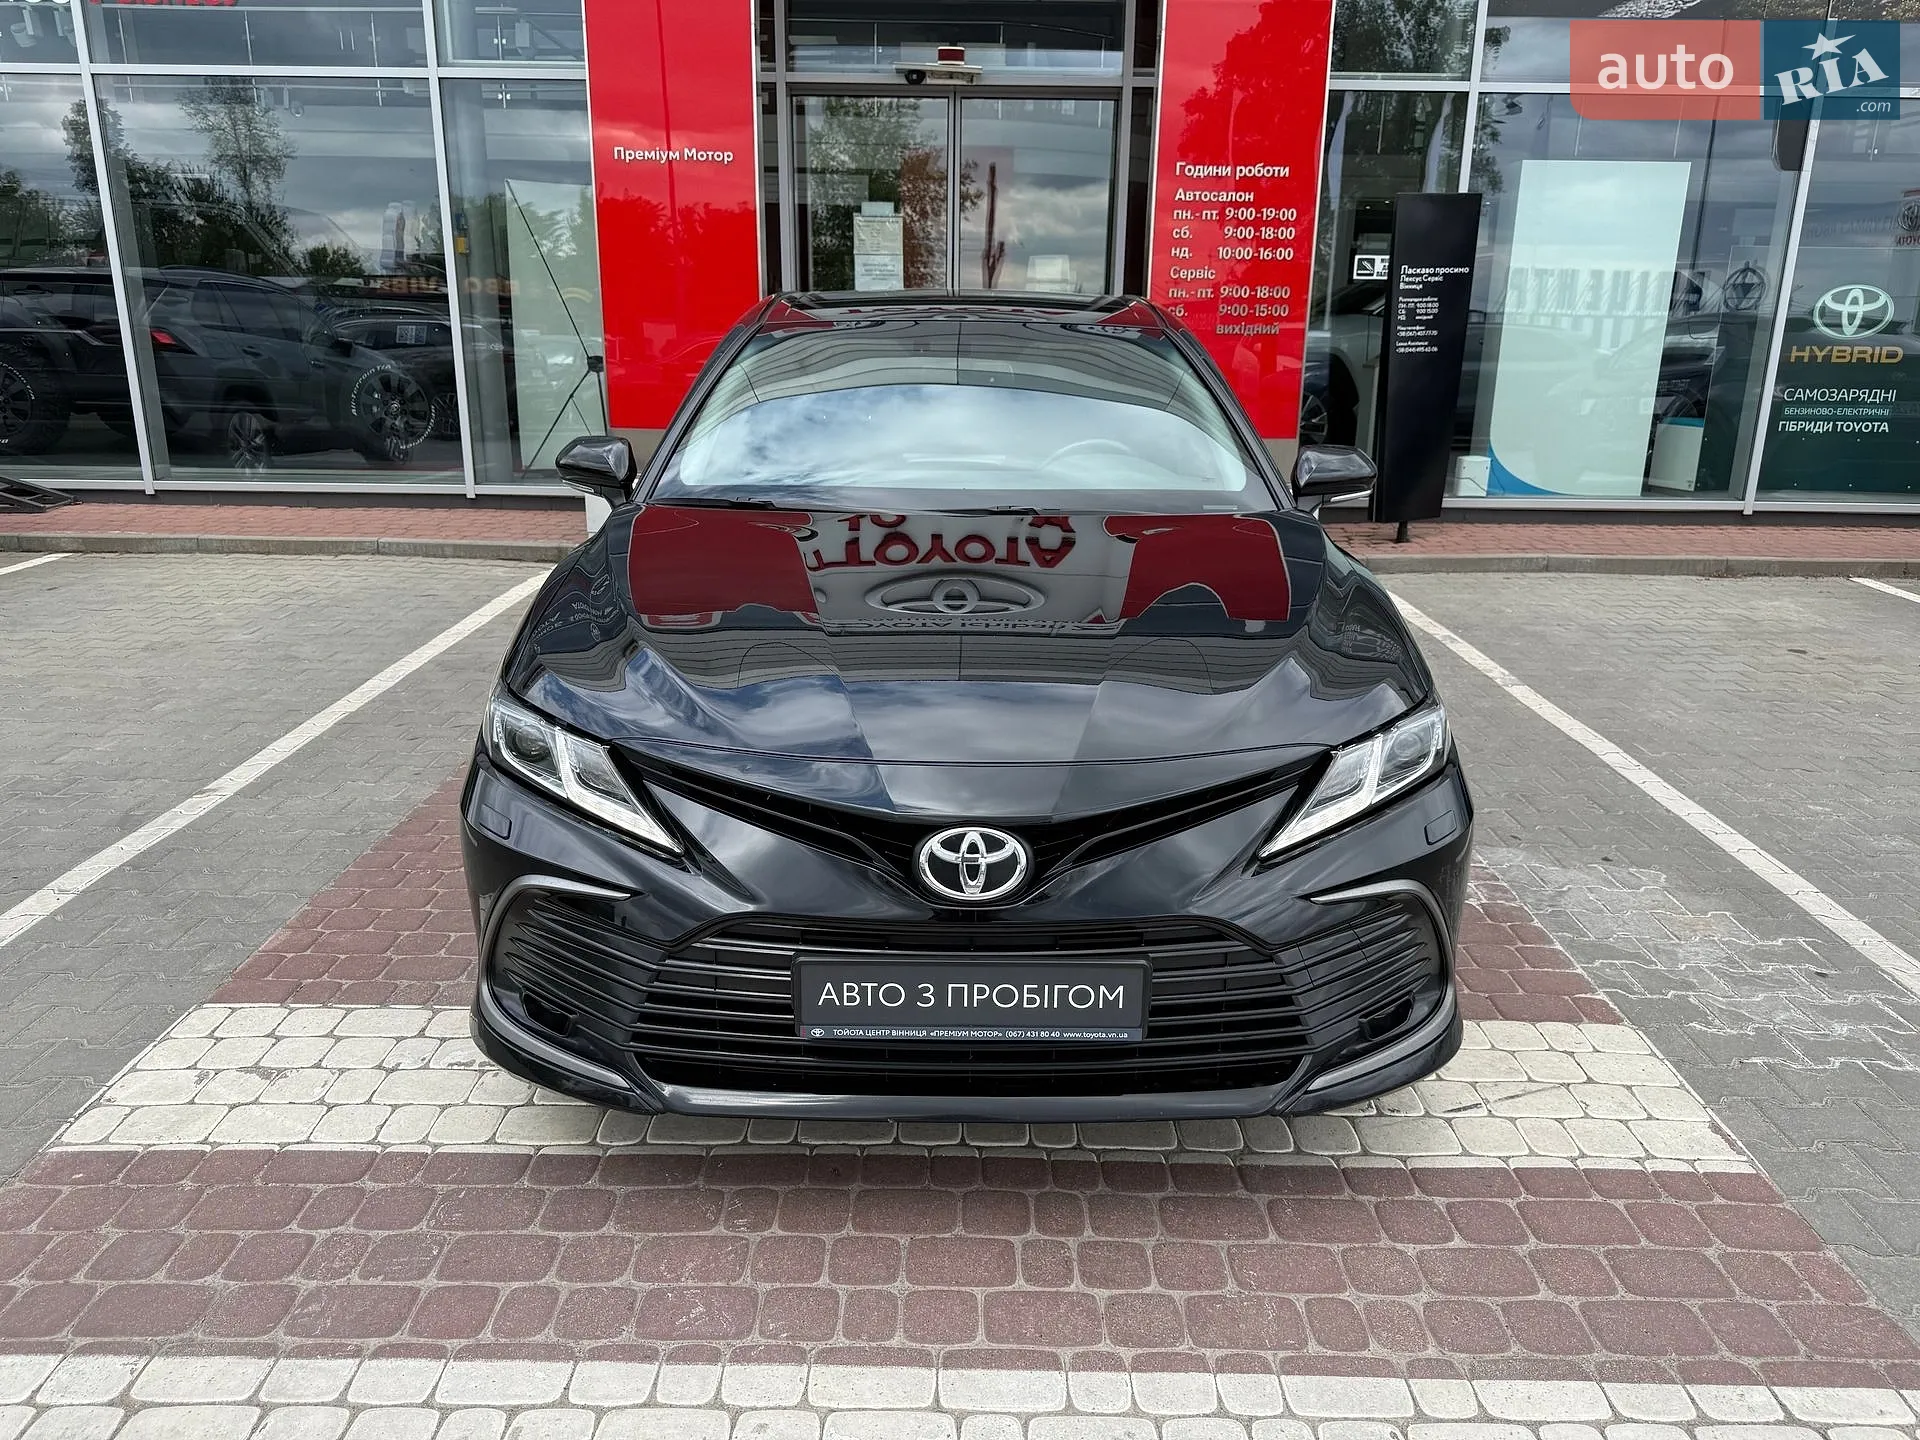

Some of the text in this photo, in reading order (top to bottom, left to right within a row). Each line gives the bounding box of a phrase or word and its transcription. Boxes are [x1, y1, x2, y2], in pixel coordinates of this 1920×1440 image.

[613, 146, 734, 164] Преміум Мотор
[1176, 162, 1289, 180] Години роботи
[1175, 188, 1254, 202] Автосалон
[1226, 208, 1296, 221] 9:00-19:00
[1172, 226, 1295, 240] сб. 9:00-18:00
[1171, 247, 1294, 260] нд. 10:00-16:00
[1170, 265, 1216, 281] Сервіс
[1401, 265, 1469, 275] Ласкаво просимо
[1220, 285, 1290, 299] 9:00-18:00
[1218, 304, 1289, 317] 9:00-15:00
[1216, 322, 1279, 336] вихідний
[1790, 345, 1904, 363] HYBRID
[1784, 388, 1896, 404] САМОЗАРЯДНІ
[1784, 407, 1889, 416] БЕНЗИНОВО-ЕЛЕКТРИЧНІ
[1778, 421, 1889, 433] ГІБРИДИ TOYOTA
[818, 982, 1124, 1009] АВТО З ПРОБІГОМ
